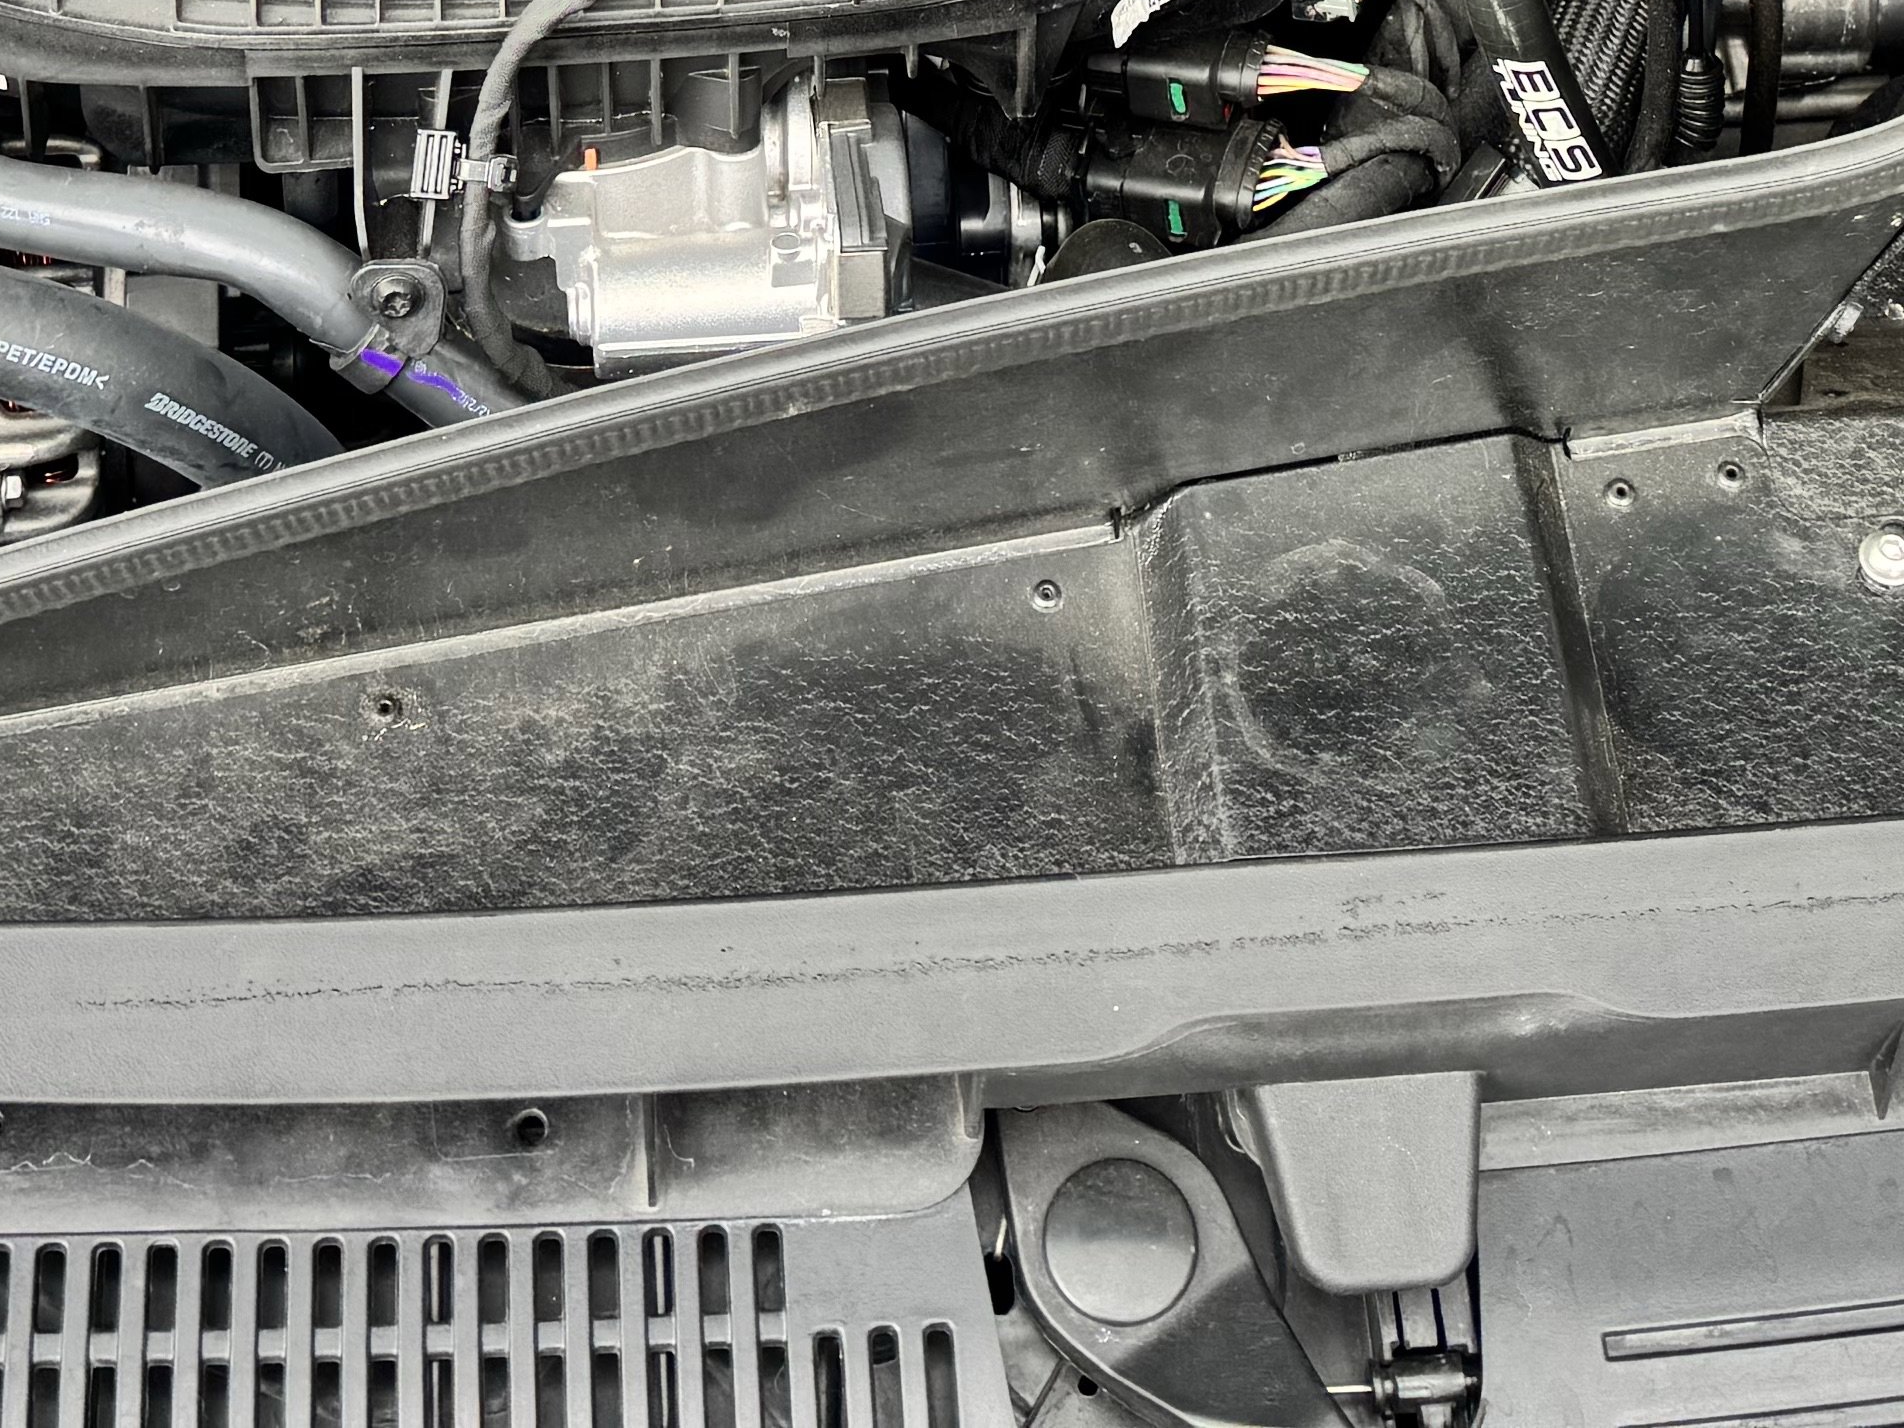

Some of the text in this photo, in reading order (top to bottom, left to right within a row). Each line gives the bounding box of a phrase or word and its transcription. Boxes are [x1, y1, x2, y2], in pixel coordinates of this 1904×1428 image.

[1492, 58, 1561, 185] TUNING
[1506, 58, 1603, 187] ECS
[145, 392, 258, 459] BRIDGESTONE
